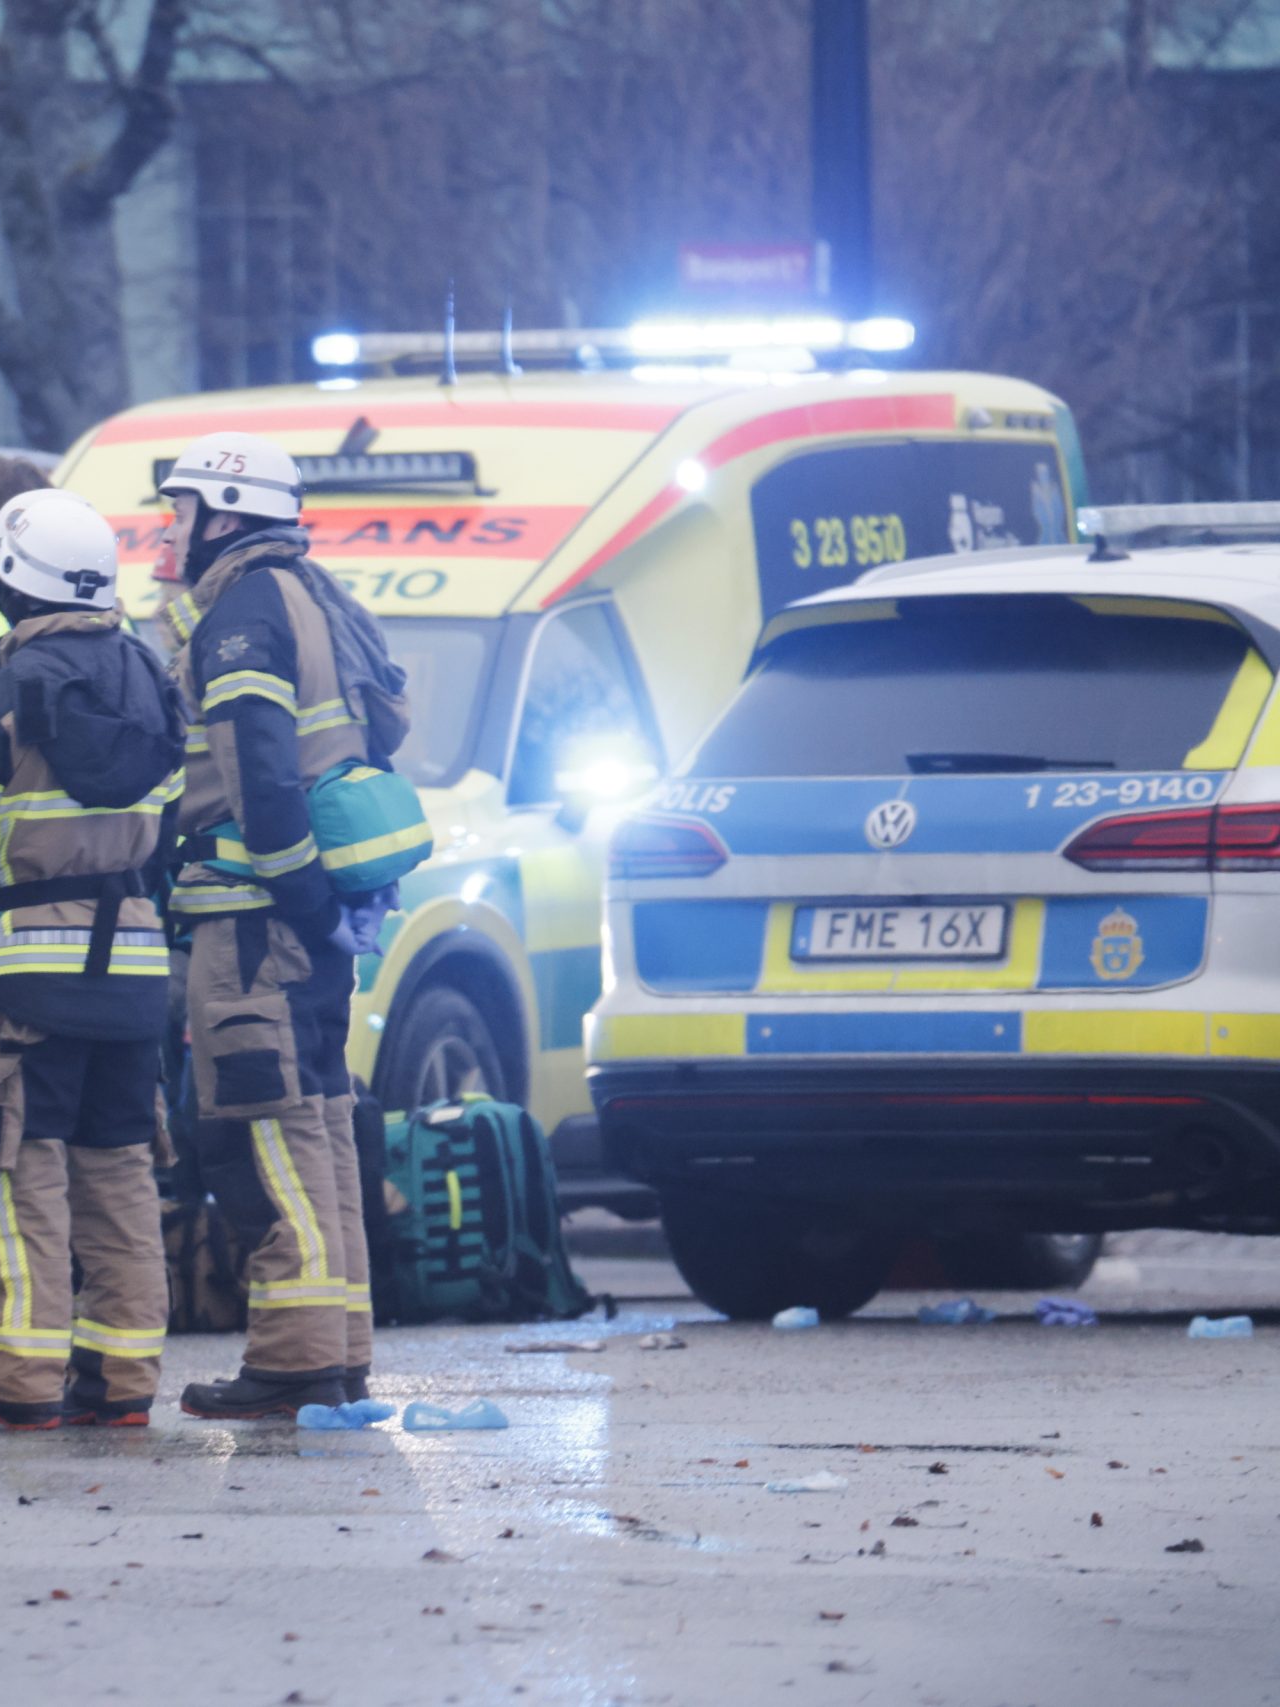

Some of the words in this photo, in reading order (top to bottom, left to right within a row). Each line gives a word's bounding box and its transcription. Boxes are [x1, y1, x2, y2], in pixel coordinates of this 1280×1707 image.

[216, 451, 247, 474] 75
[790, 518, 812, 569] 3
[815, 517, 849, 567] 23
[1025, 784, 1041, 808] 1
[1052, 776, 1213, 807] 23-9140
[826, 911, 900, 949] FME
[918, 911, 987, 948] 16X
